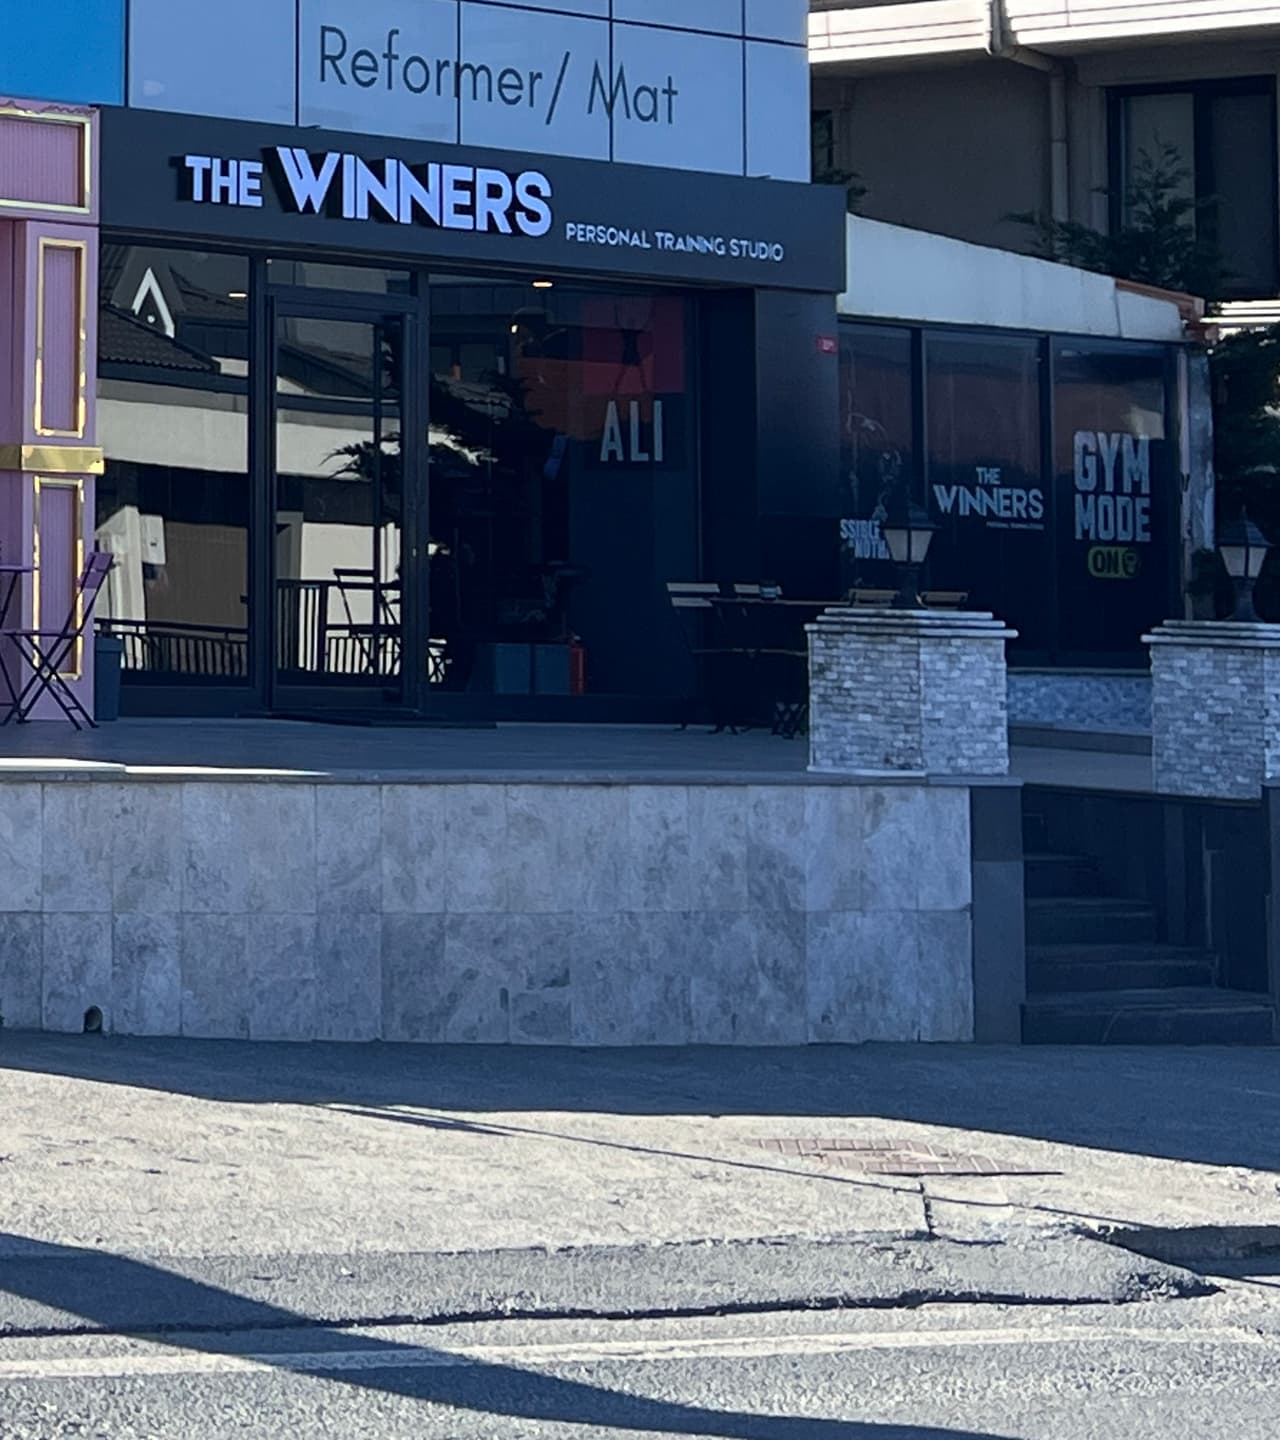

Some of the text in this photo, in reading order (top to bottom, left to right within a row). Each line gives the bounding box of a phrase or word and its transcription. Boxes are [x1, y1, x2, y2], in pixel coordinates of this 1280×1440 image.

[587, 59, 679, 124] Mat
[184, 146, 553, 237] THE WINNERS
[565, 222, 784, 262] PERSONAL TRAINING STUDIO
[600, 400, 663, 461] ALI
[976, 466, 1001, 485] THE
[1073, 430, 1150, 494] GYM
[932, 484, 1045, 520] WINNERS
[1073, 493, 1152, 542] MODE
[1091, 549, 1119, 575] ON
